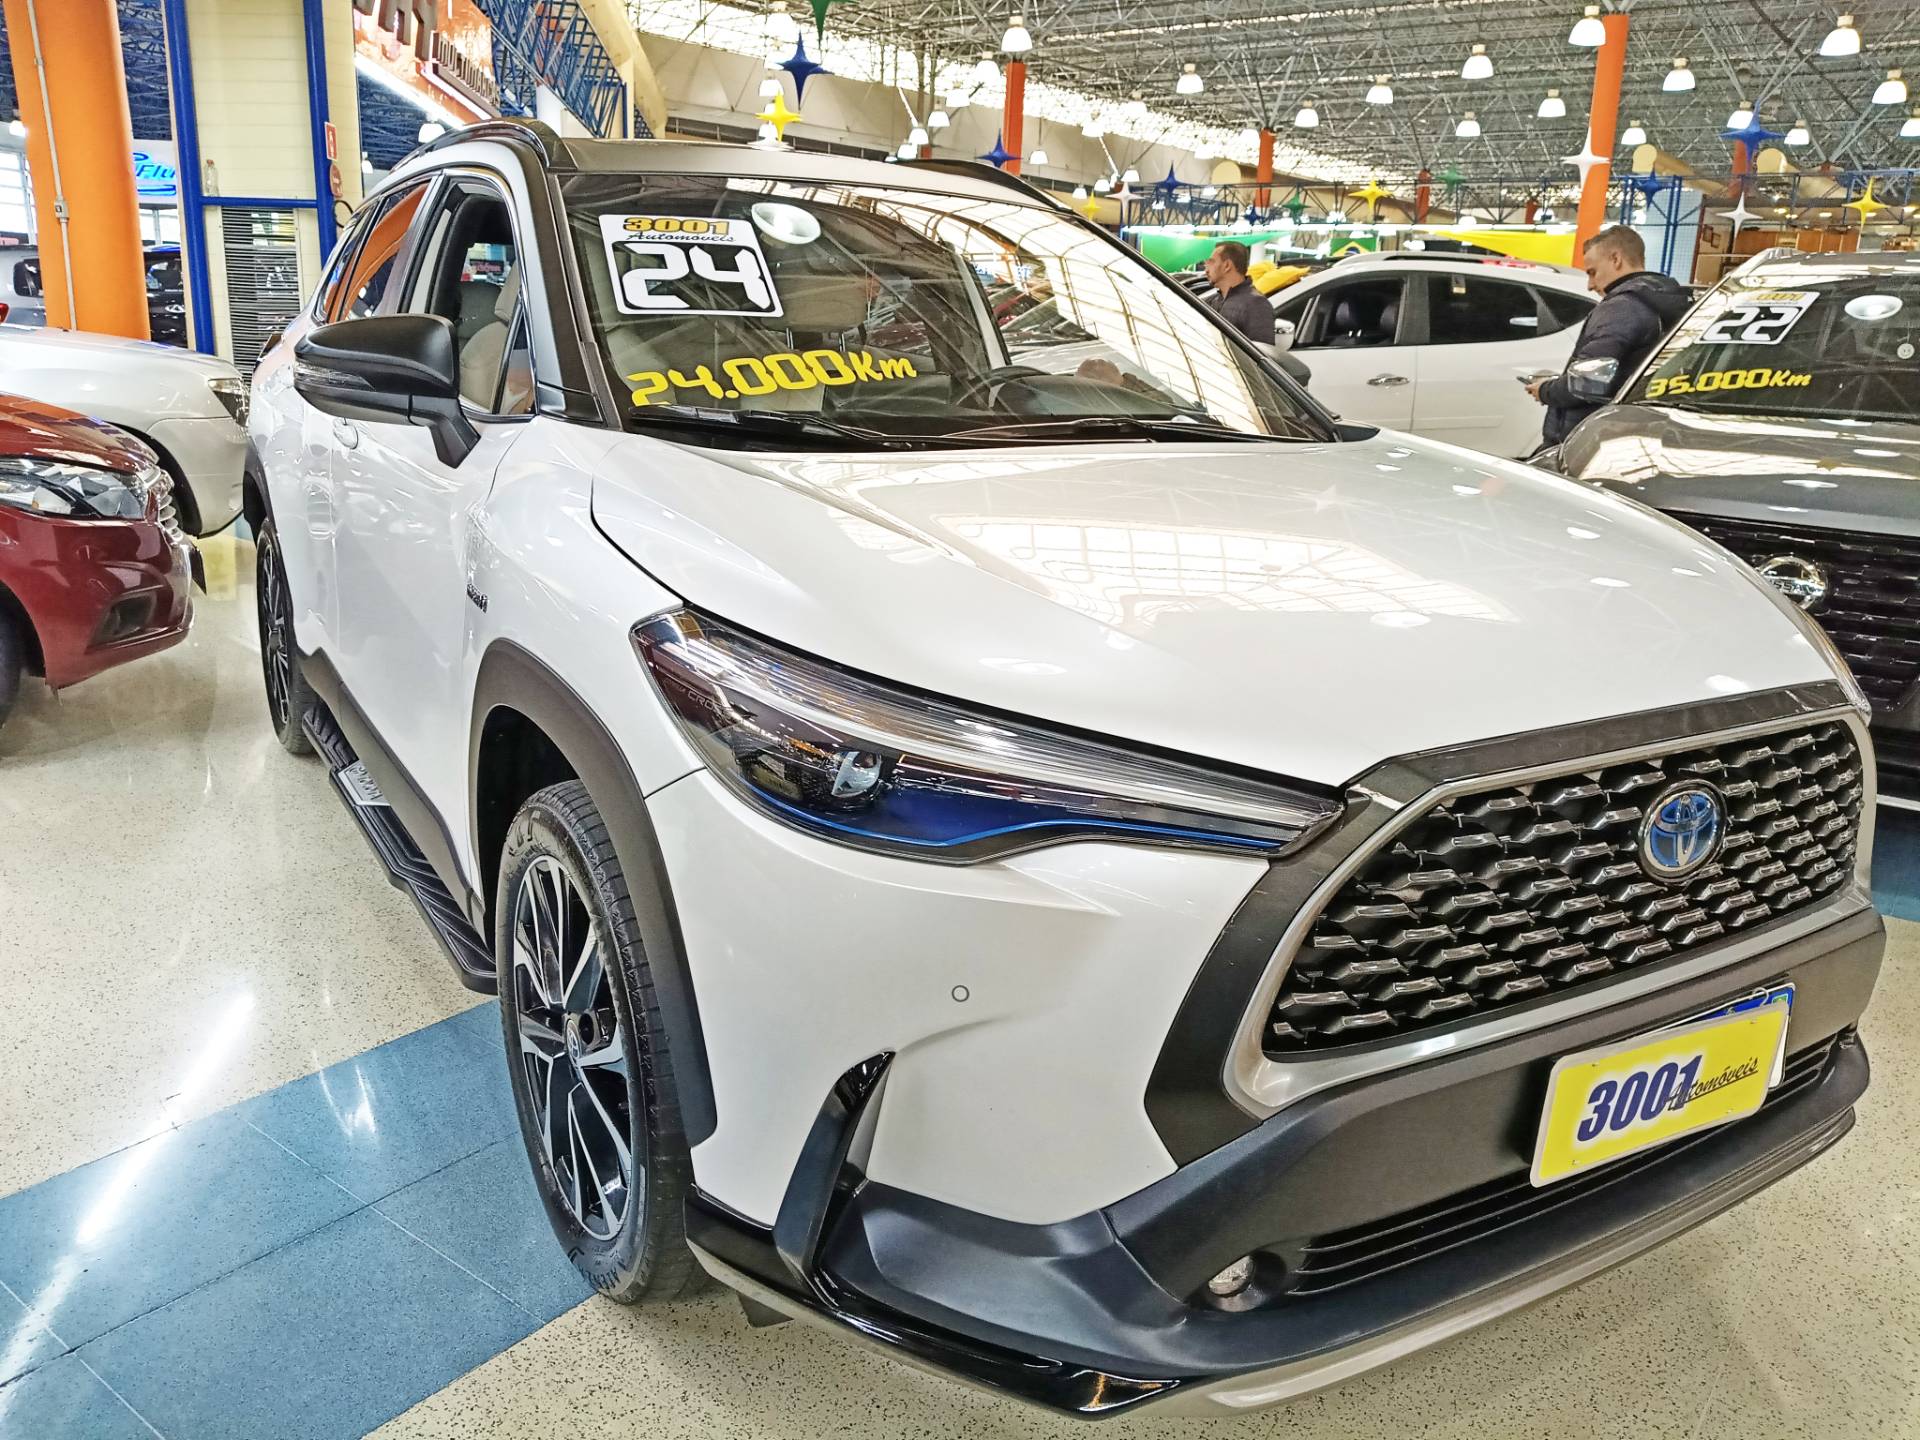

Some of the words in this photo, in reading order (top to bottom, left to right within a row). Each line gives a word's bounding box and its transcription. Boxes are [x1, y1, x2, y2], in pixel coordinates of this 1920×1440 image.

[624, 217, 729, 236] 3001
[622, 242, 771, 310] 24
[1703, 306, 1801, 341] 22
[626, 349, 917, 406] 24.000Km
[1645, 368, 1812, 398] 35.000Km
[1577, 1055, 1702, 1141] 3001
